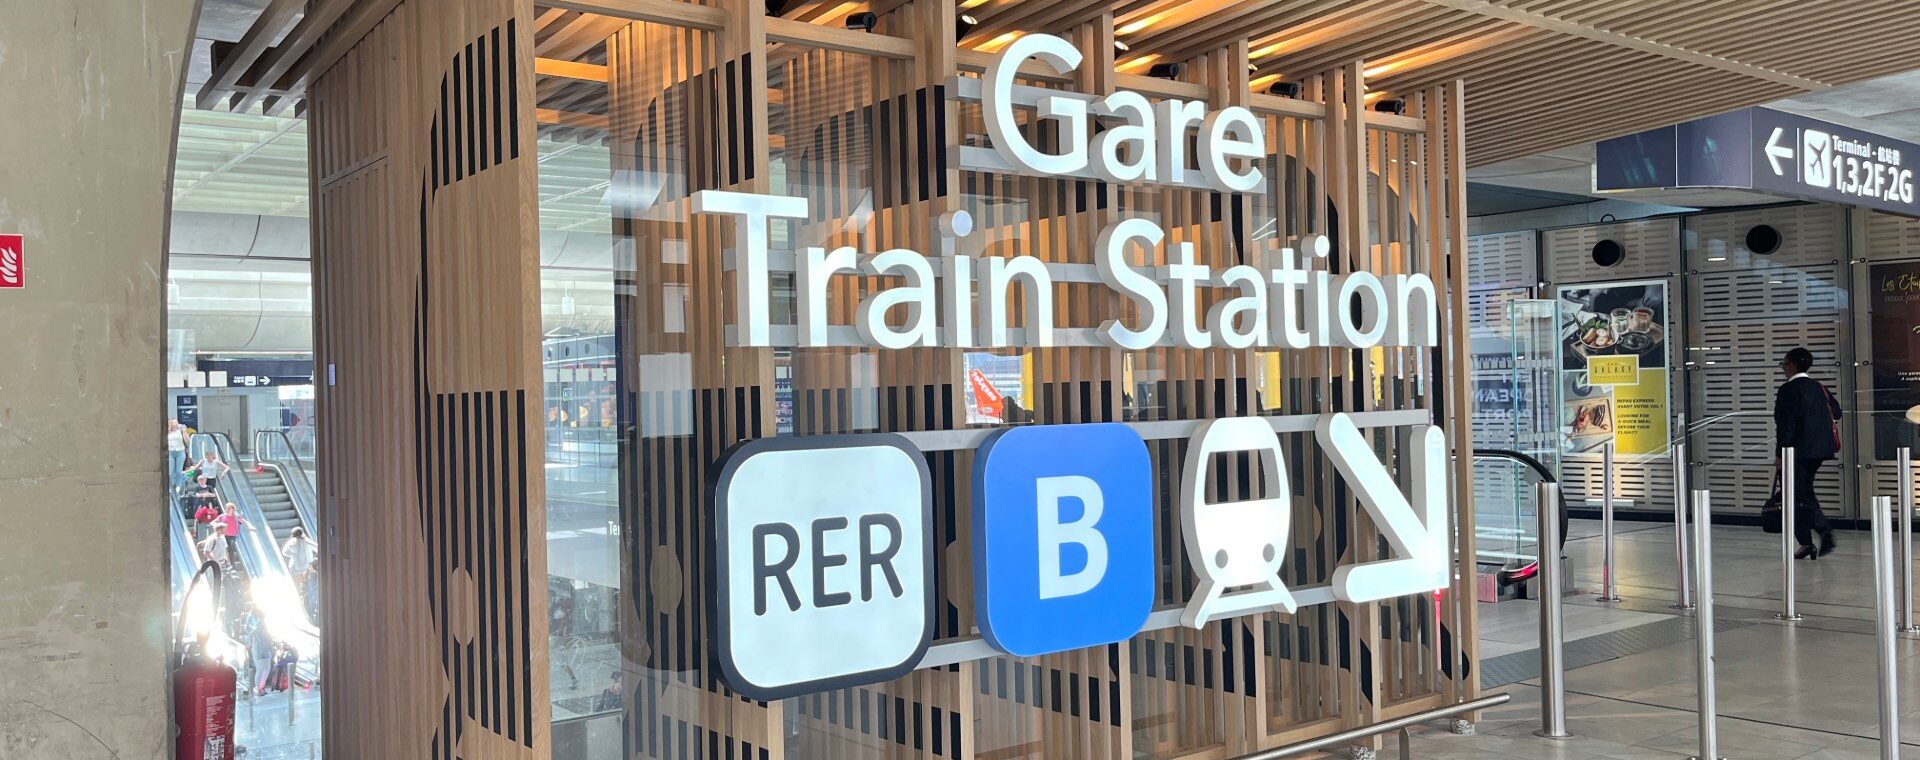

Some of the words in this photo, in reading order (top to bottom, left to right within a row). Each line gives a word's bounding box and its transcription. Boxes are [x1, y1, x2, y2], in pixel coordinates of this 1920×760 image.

[984, 33, 1267, 193] Gare
[1832, 134, 1871, 158] Terminal
[692, 188, 1054, 349] Train
[1098, 218, 1438, 351] Station
[752, 513, 903, 616] RER
[1036, 475, 1108, 600] B
